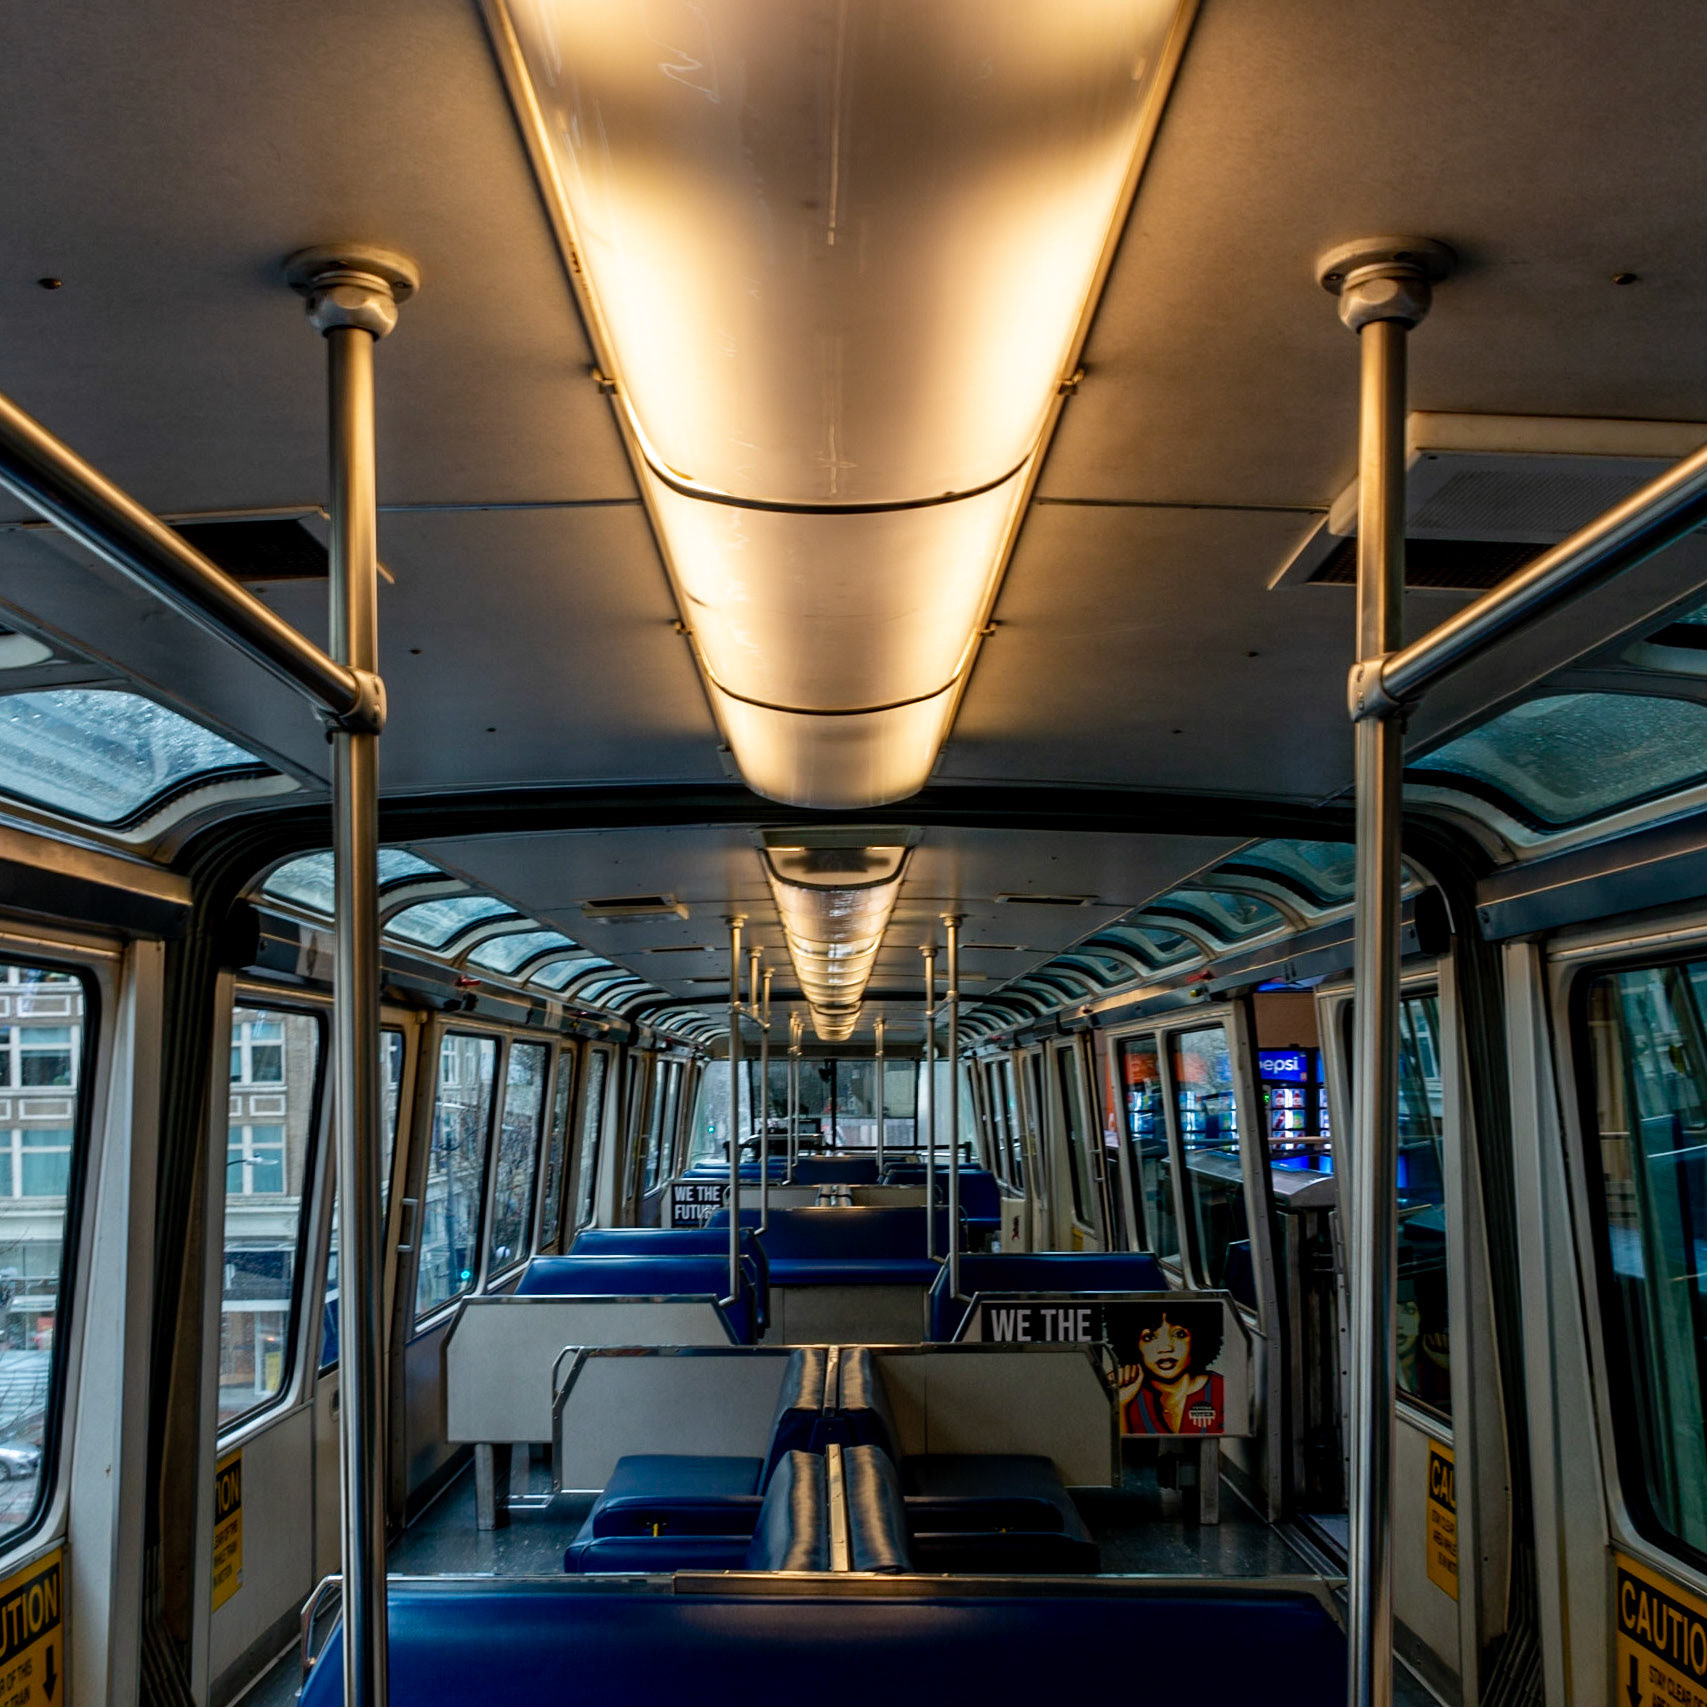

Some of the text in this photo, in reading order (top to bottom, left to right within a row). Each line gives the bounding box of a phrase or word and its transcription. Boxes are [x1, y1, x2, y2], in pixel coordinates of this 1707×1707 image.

[674, 1186, 721, 1202] WE THE
[991, 1308, 1092, 1341] WE THE
